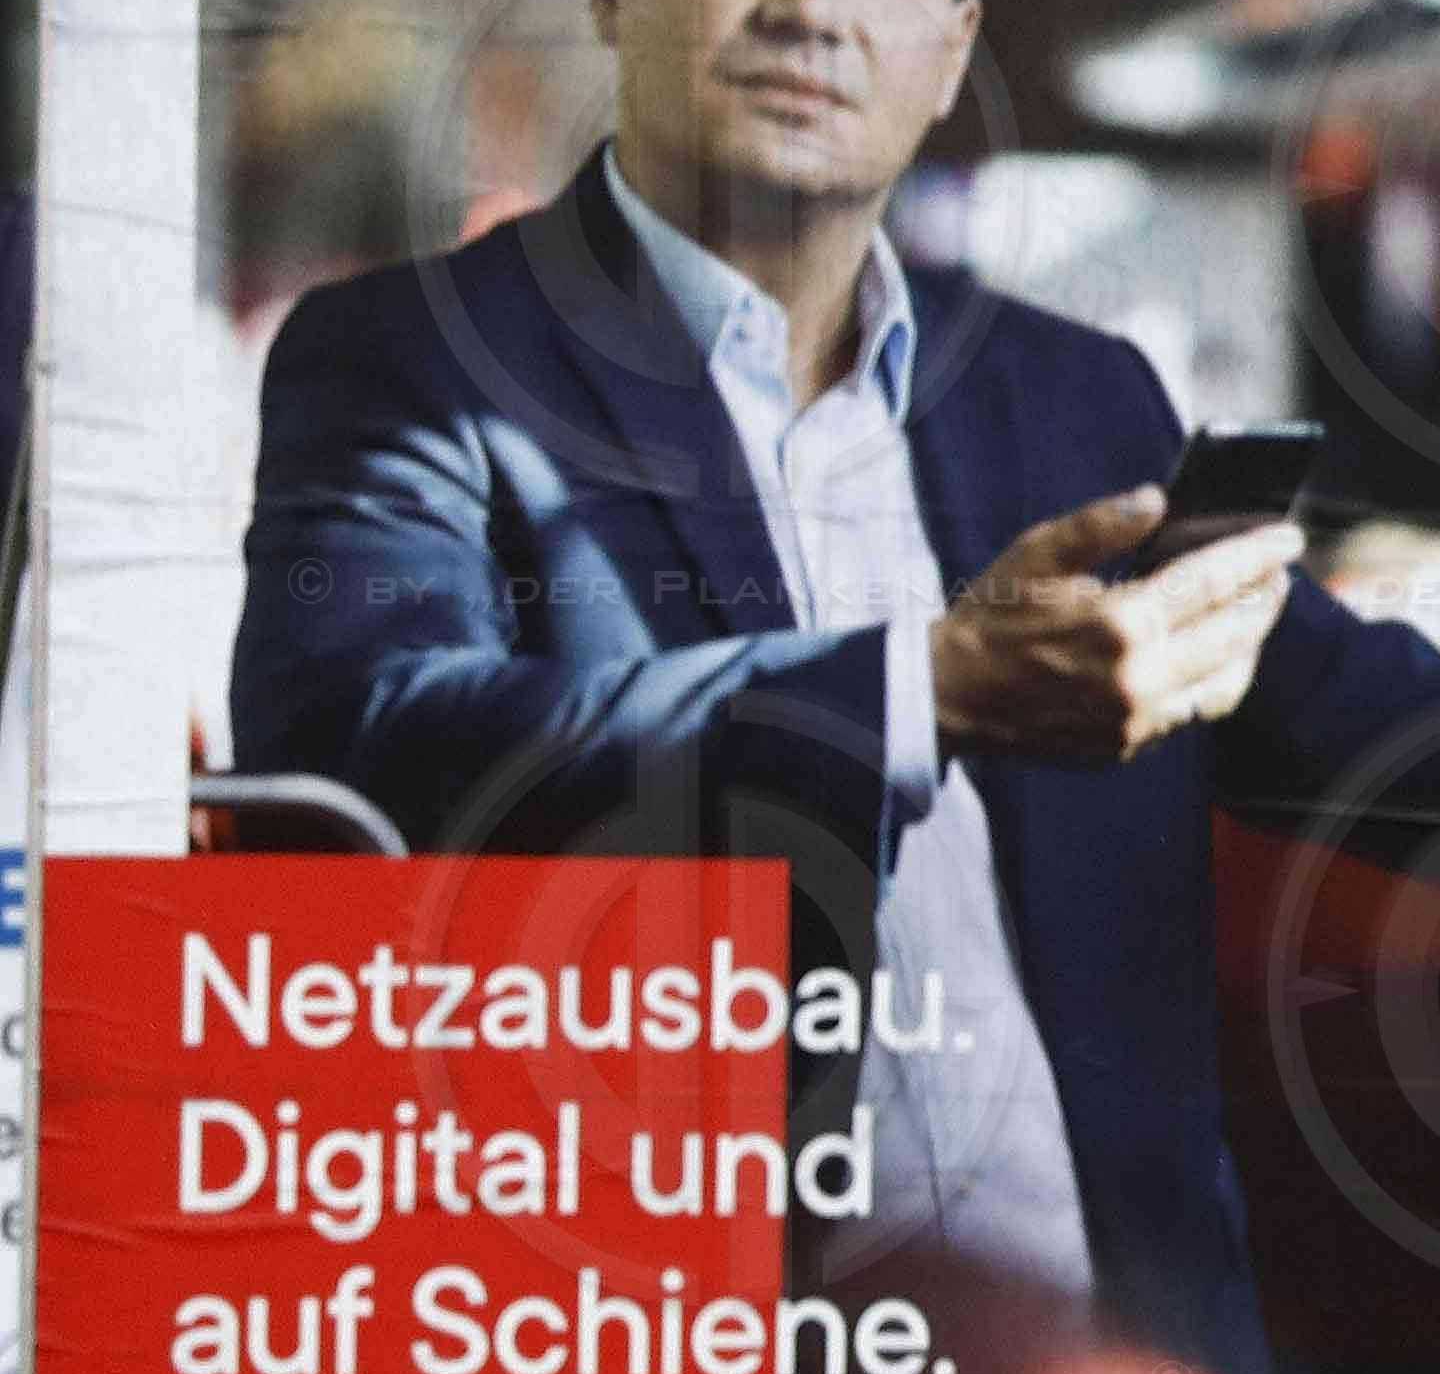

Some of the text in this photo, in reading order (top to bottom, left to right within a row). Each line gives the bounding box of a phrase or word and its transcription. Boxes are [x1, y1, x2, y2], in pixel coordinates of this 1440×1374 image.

[180, 933, 975, 1053] Netzausbau.
[177, 1098, 877, 1244] Digital und
